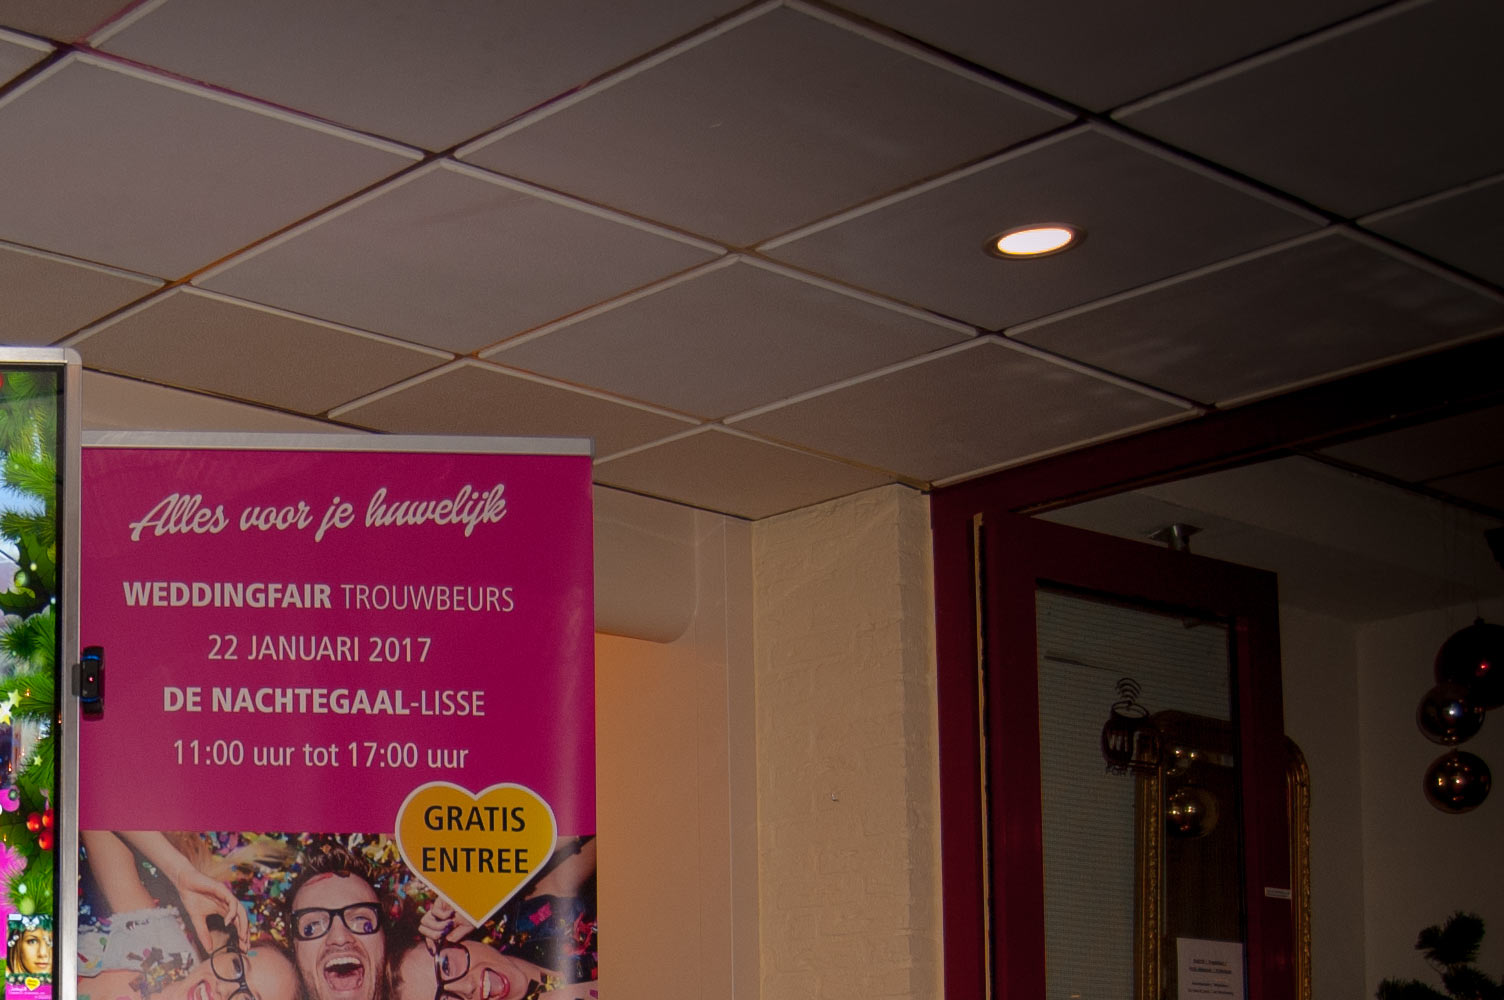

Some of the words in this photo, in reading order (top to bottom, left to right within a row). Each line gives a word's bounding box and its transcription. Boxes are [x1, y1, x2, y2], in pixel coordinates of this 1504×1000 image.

[130, 493, 228, 541] Alles
[239, 505, 312, 531] voor
[315, 496, 355, 543] je
[365, 484, 507, 537] huwelijk
[123, 581, 332, 609] WEDDINGFAIR
[341, 584, 515, 612] TROUWBEURS
[208, 634, 238, 661] 22
[248, 635, 359, 662] JANUARI
[369, 637, 431, 663] 2017
[163, 687, 202, 713] DE
[212, 687, 486, 717] NACHTEGAAL-LISSE
[173, 740, 244, 766] 11:00
[253, 746, 295, 767] uur
[303, 743, 339, 767] tot
[348, 742, 418, 768] 17:00
[427, 748, 469, 769] uur
[424, 804, 527, 833] GRATIS
[421, 847, 530, 874] ENTREE
